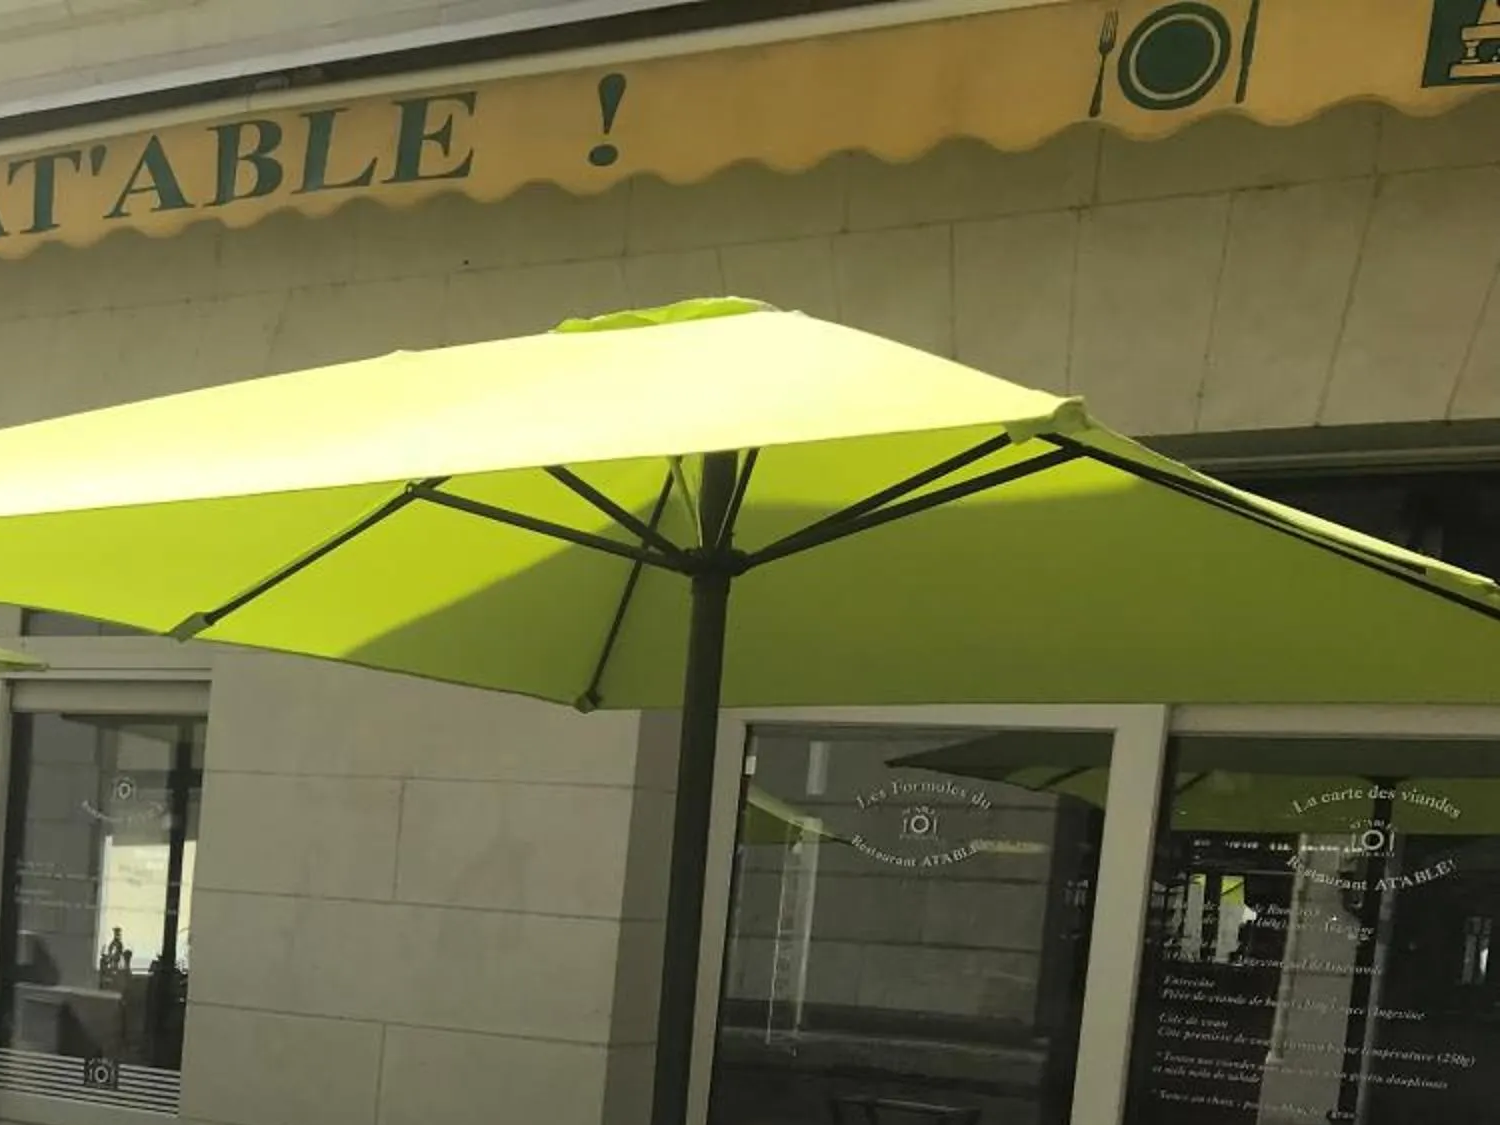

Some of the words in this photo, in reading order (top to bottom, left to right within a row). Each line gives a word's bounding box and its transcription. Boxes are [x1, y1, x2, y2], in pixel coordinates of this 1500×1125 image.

[971, 792, 992, 810] du
[1292, 796, 1319, 814] La
[1321, 788, 1363, 804] carte
[1368, 784, 1396, 800] des
[1401, 788, 1461, 819] viandes
[851, 834, 917, 867] Restaurant
[1286, 855, 1368, 890] Restaurant
